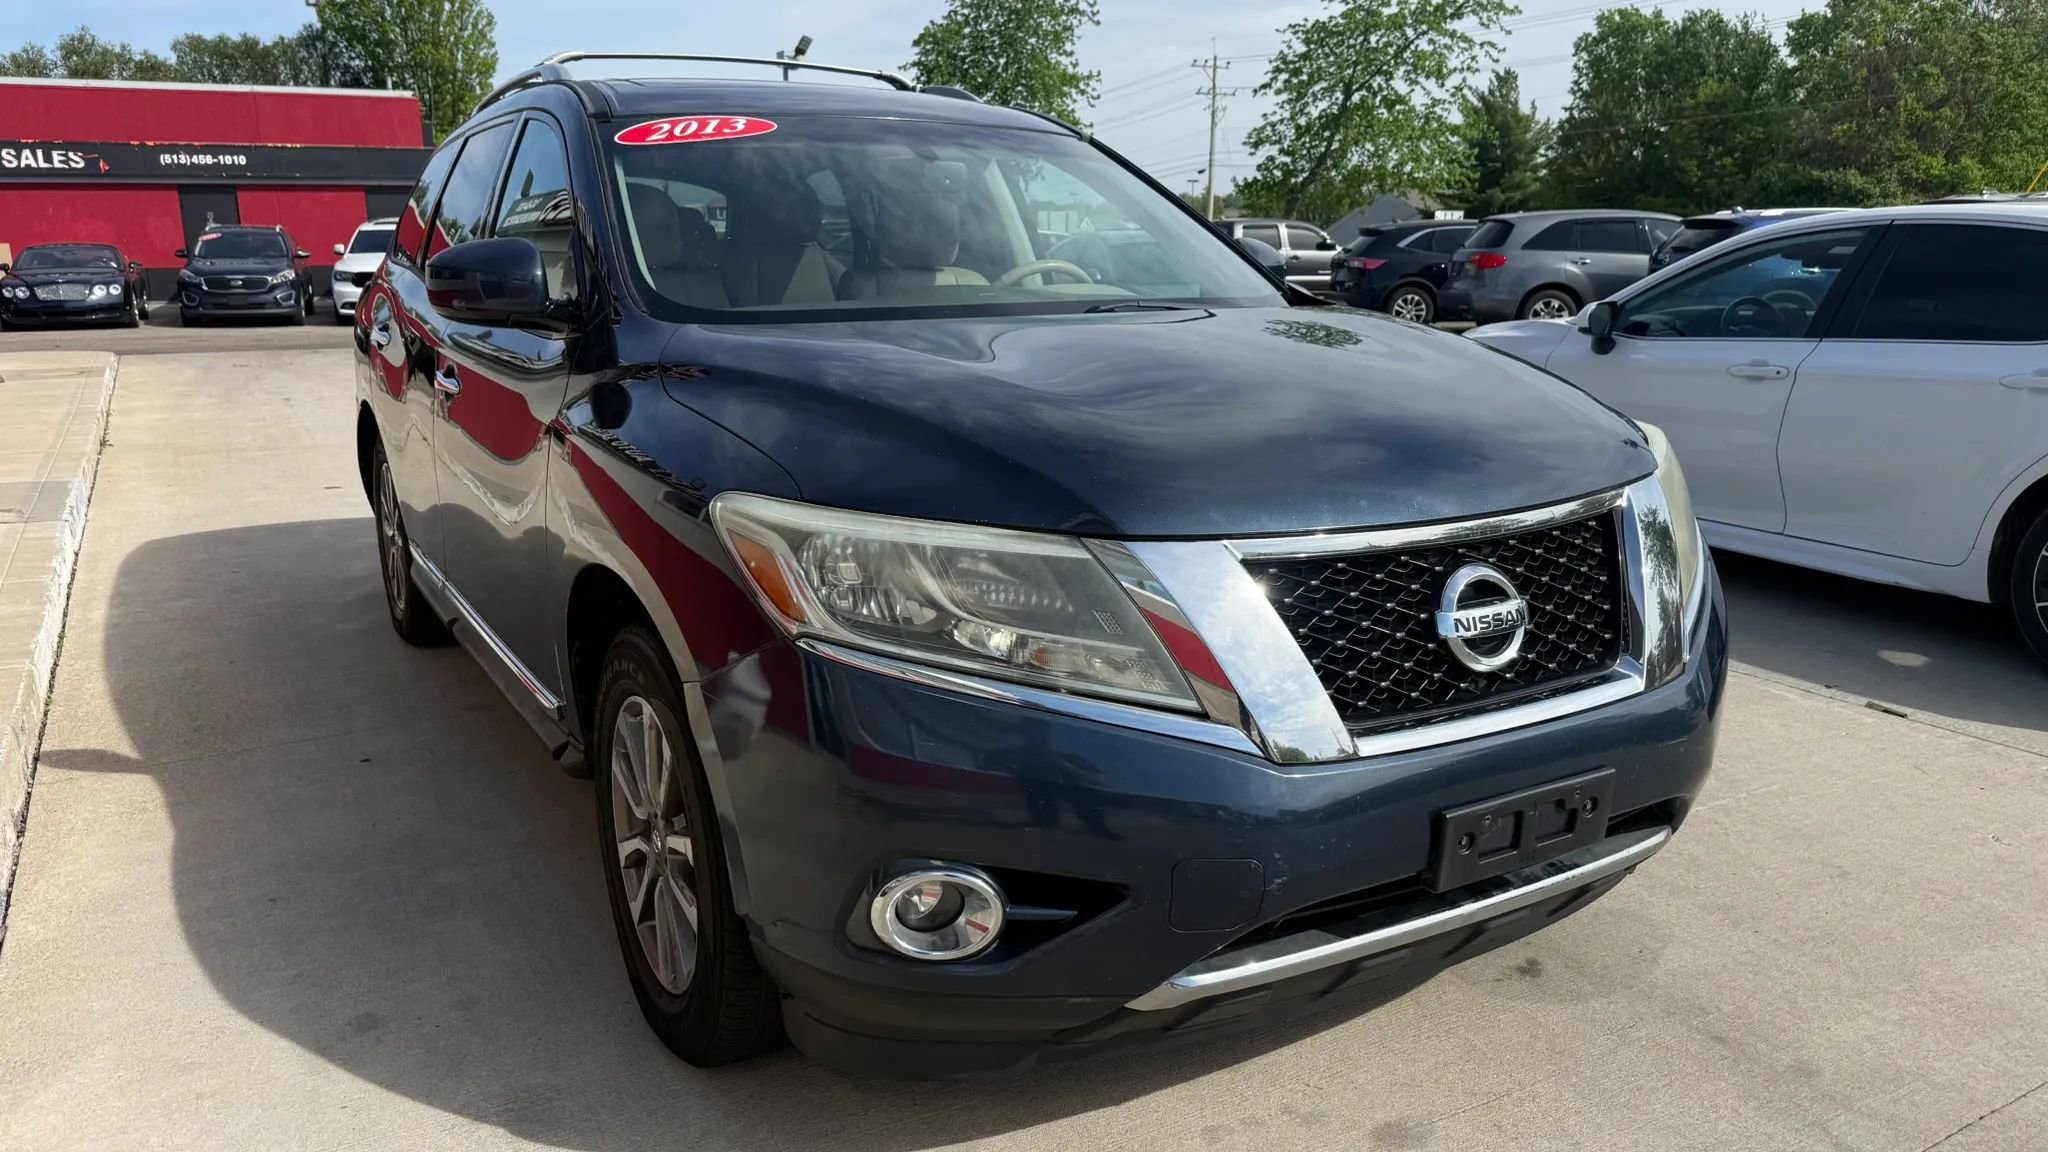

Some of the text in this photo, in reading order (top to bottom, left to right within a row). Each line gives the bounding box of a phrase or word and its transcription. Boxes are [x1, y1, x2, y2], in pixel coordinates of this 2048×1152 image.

[645, 117, 748, 141] 2013
[1, 148, 86, 169] SALES
[1453, 605, 1526, 634] NISSAN
